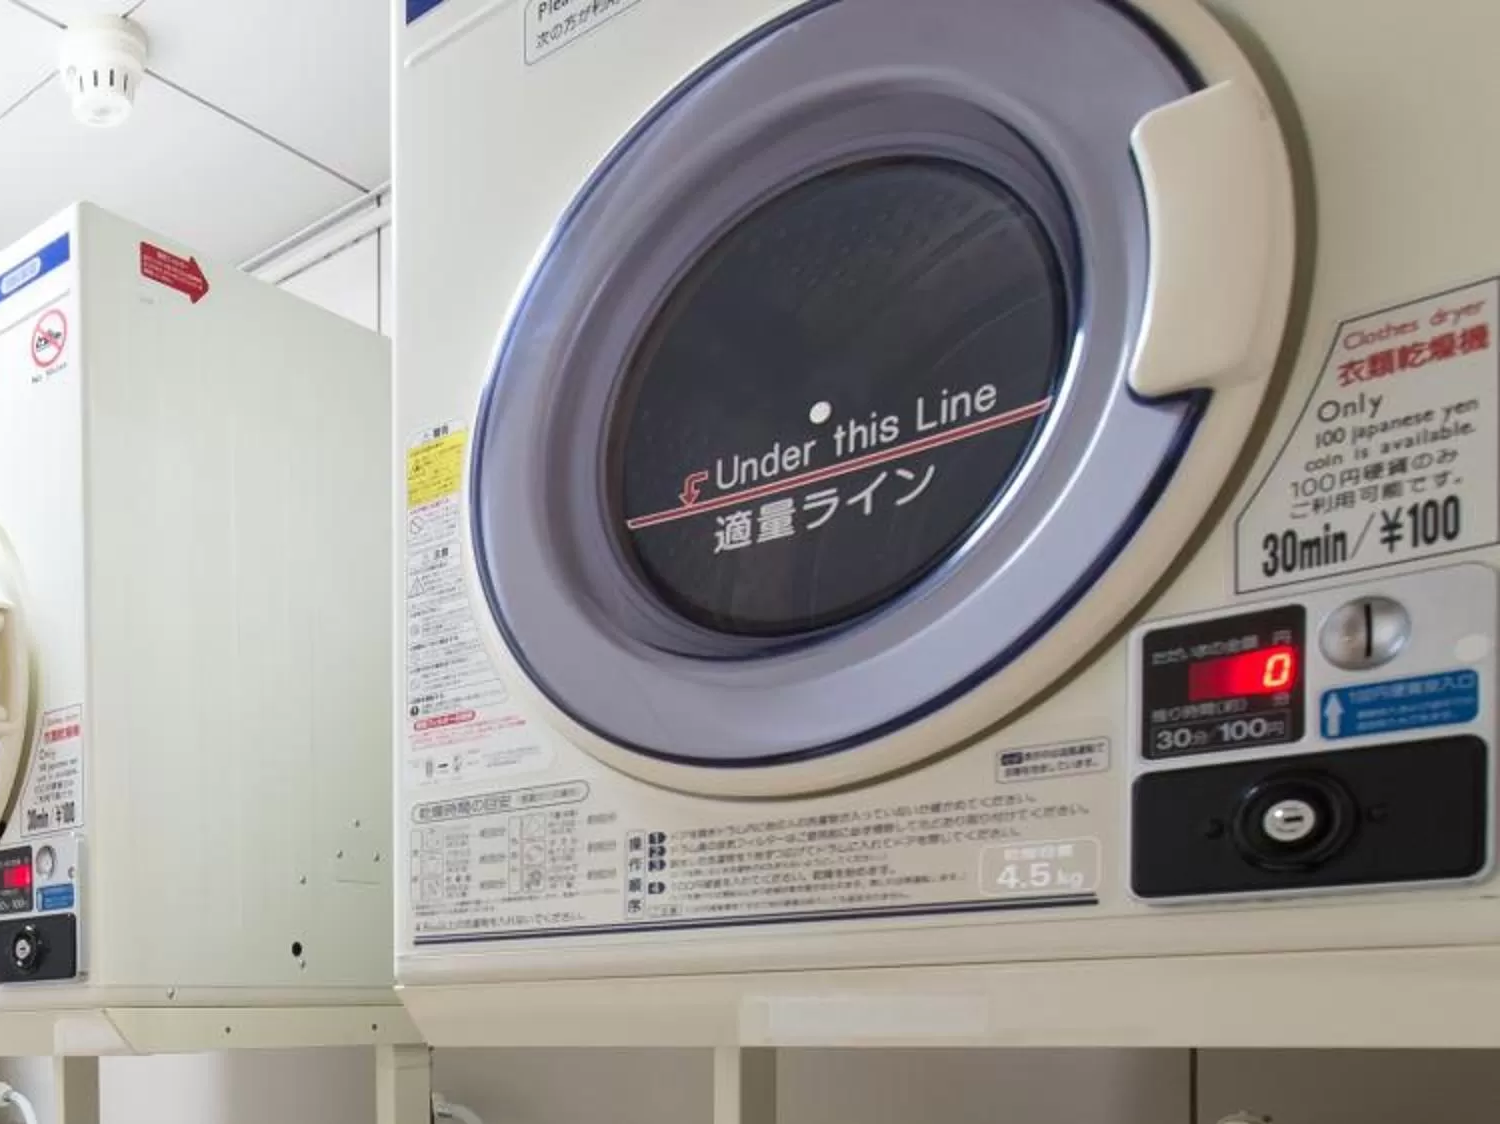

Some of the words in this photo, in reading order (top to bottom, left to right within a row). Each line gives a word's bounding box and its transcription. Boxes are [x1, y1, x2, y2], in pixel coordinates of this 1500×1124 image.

[1343, 319, 1418, 350] Clothes
[1429, 300, 1486, 327] dryer
[1337, 323, 1489, 388] 衣類乾燥機
[1316, 426, 1345, 449] 100
[1442, 399, 1479, 421] yen
[1317, 392, 1382, 422] Only
[715, 440, 816, 490] Under
[833, 412, 899, 457] this
[916, 383, 998, 432] Line
[1305, 453, 1343, 474] coin
[1354, 443, 1368, 460] is
[713, 464, 936, 554] 適量ライン
[1262, 652, 1292, 689] 0
